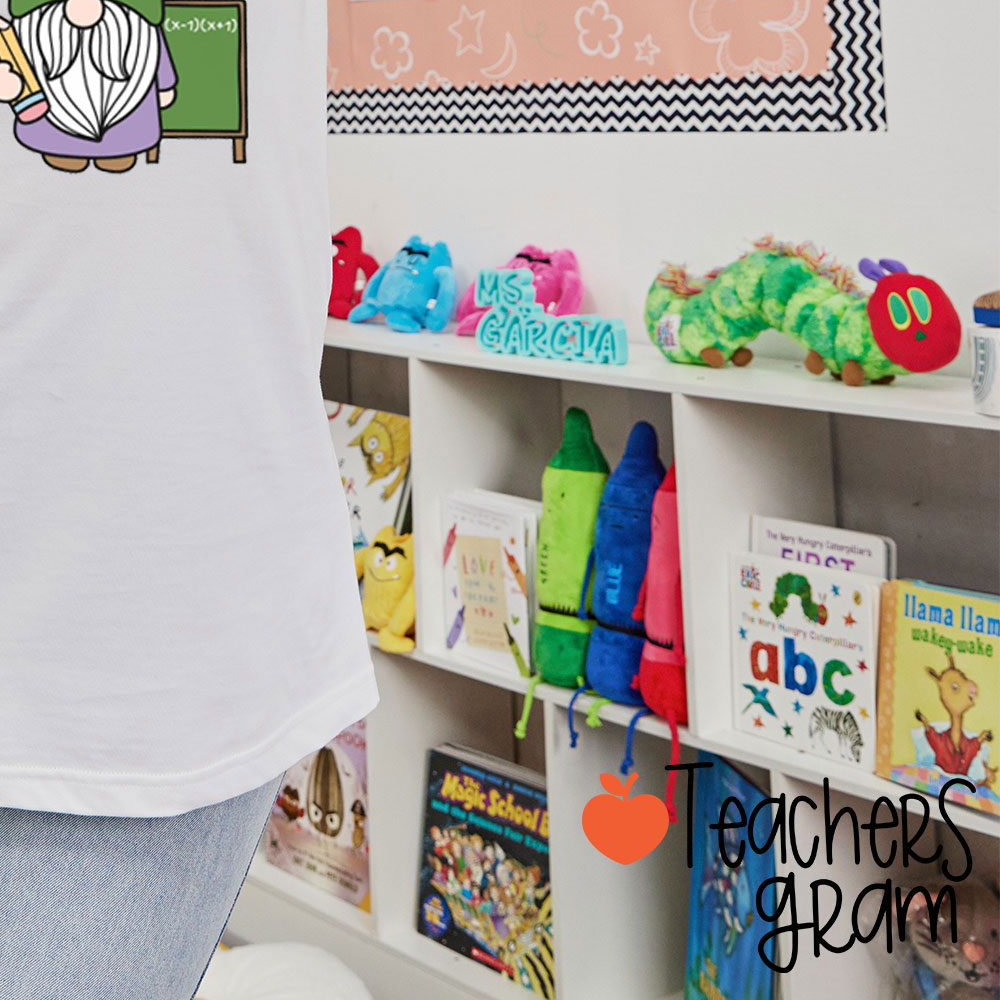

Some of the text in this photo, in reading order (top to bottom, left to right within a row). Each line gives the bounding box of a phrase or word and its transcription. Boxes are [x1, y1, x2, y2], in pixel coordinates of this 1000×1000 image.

[477, 271, 524, 305] MS
[479, 310, 618, 363] GARCIA
[904, 593, 954, 628] llama
[750, 637, 855, 706] abc
[441, 771, 486, 811] Magic
[487, 788, 540, 833] School
